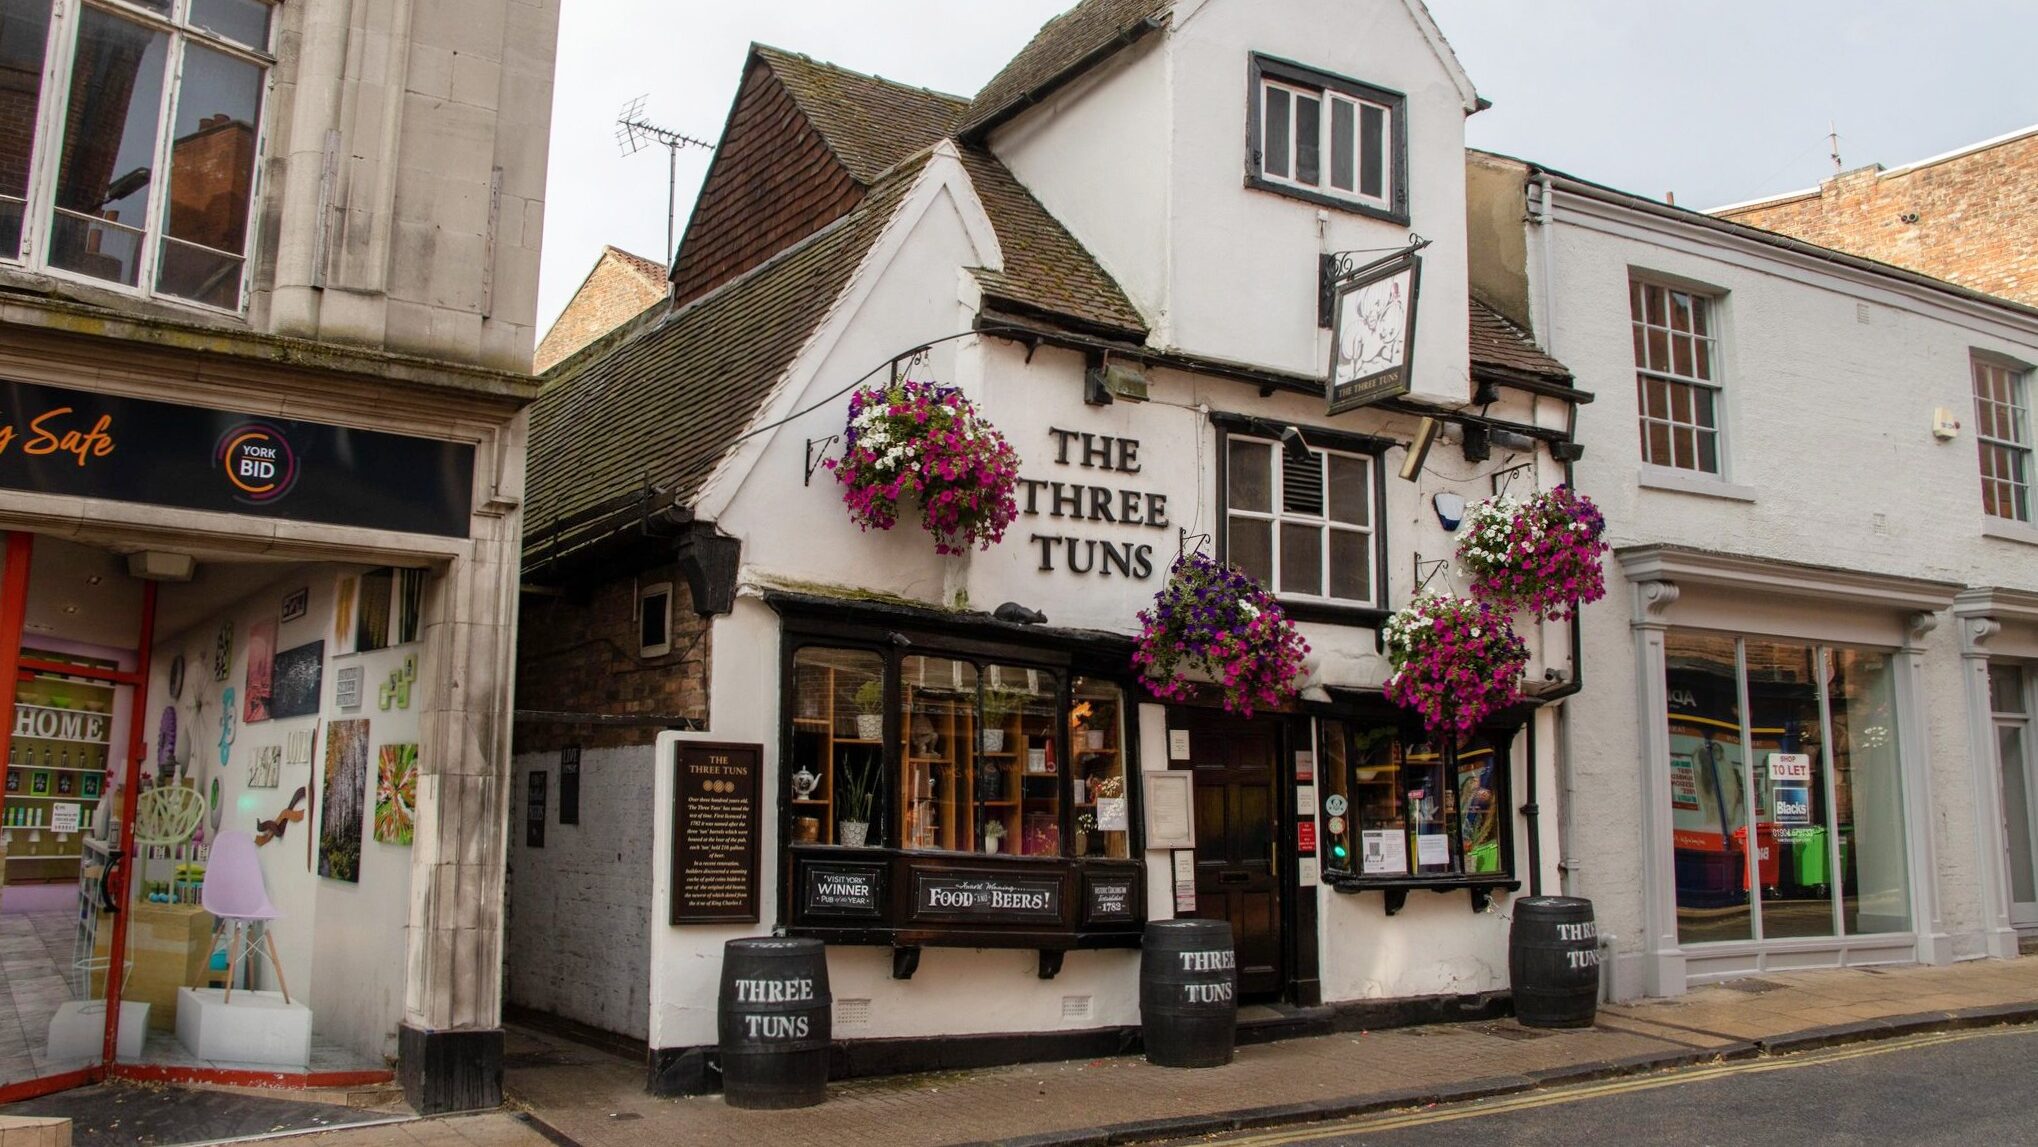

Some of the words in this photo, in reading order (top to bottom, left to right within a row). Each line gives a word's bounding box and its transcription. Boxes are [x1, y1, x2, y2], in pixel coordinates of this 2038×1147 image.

[1338, 386, 1353, 398] THE
[1353, 378, 1377, 393] THREE
[1379, 371, 1399, 385] TUNS
[23, 407, 118, 467] Safe
[242, 445, 276, 459] YORK
[1049, 425, 1141, 473] THE
[240, 460, 275, 479] BID
[1017, 477, 1170, 528] THREE
[1031, 533, 1153, 579] TUNS
[12, 706, 104, 741] HOME
[689, 765, 720, 774] THREE
[723, 766, 748, 776] TUNS
[709, 756, 728, 765] THE
[1772, 765, 1785, 775] TO
[1788, 765, 1806, 776] LET
[1776, 801, 1807, 814] Blacks
[818, 883, 869, 896] WINNER
[821, 895, 834, 903] PUB
[928, 888, 973, 907] FOOD
[1179, 950, 1236, 970] THREE
[735, 979, 814, 1003] THREE
[1184, 982, 1232, 1003] TUNS
[745, 1015, 809, 1038] TUNS
